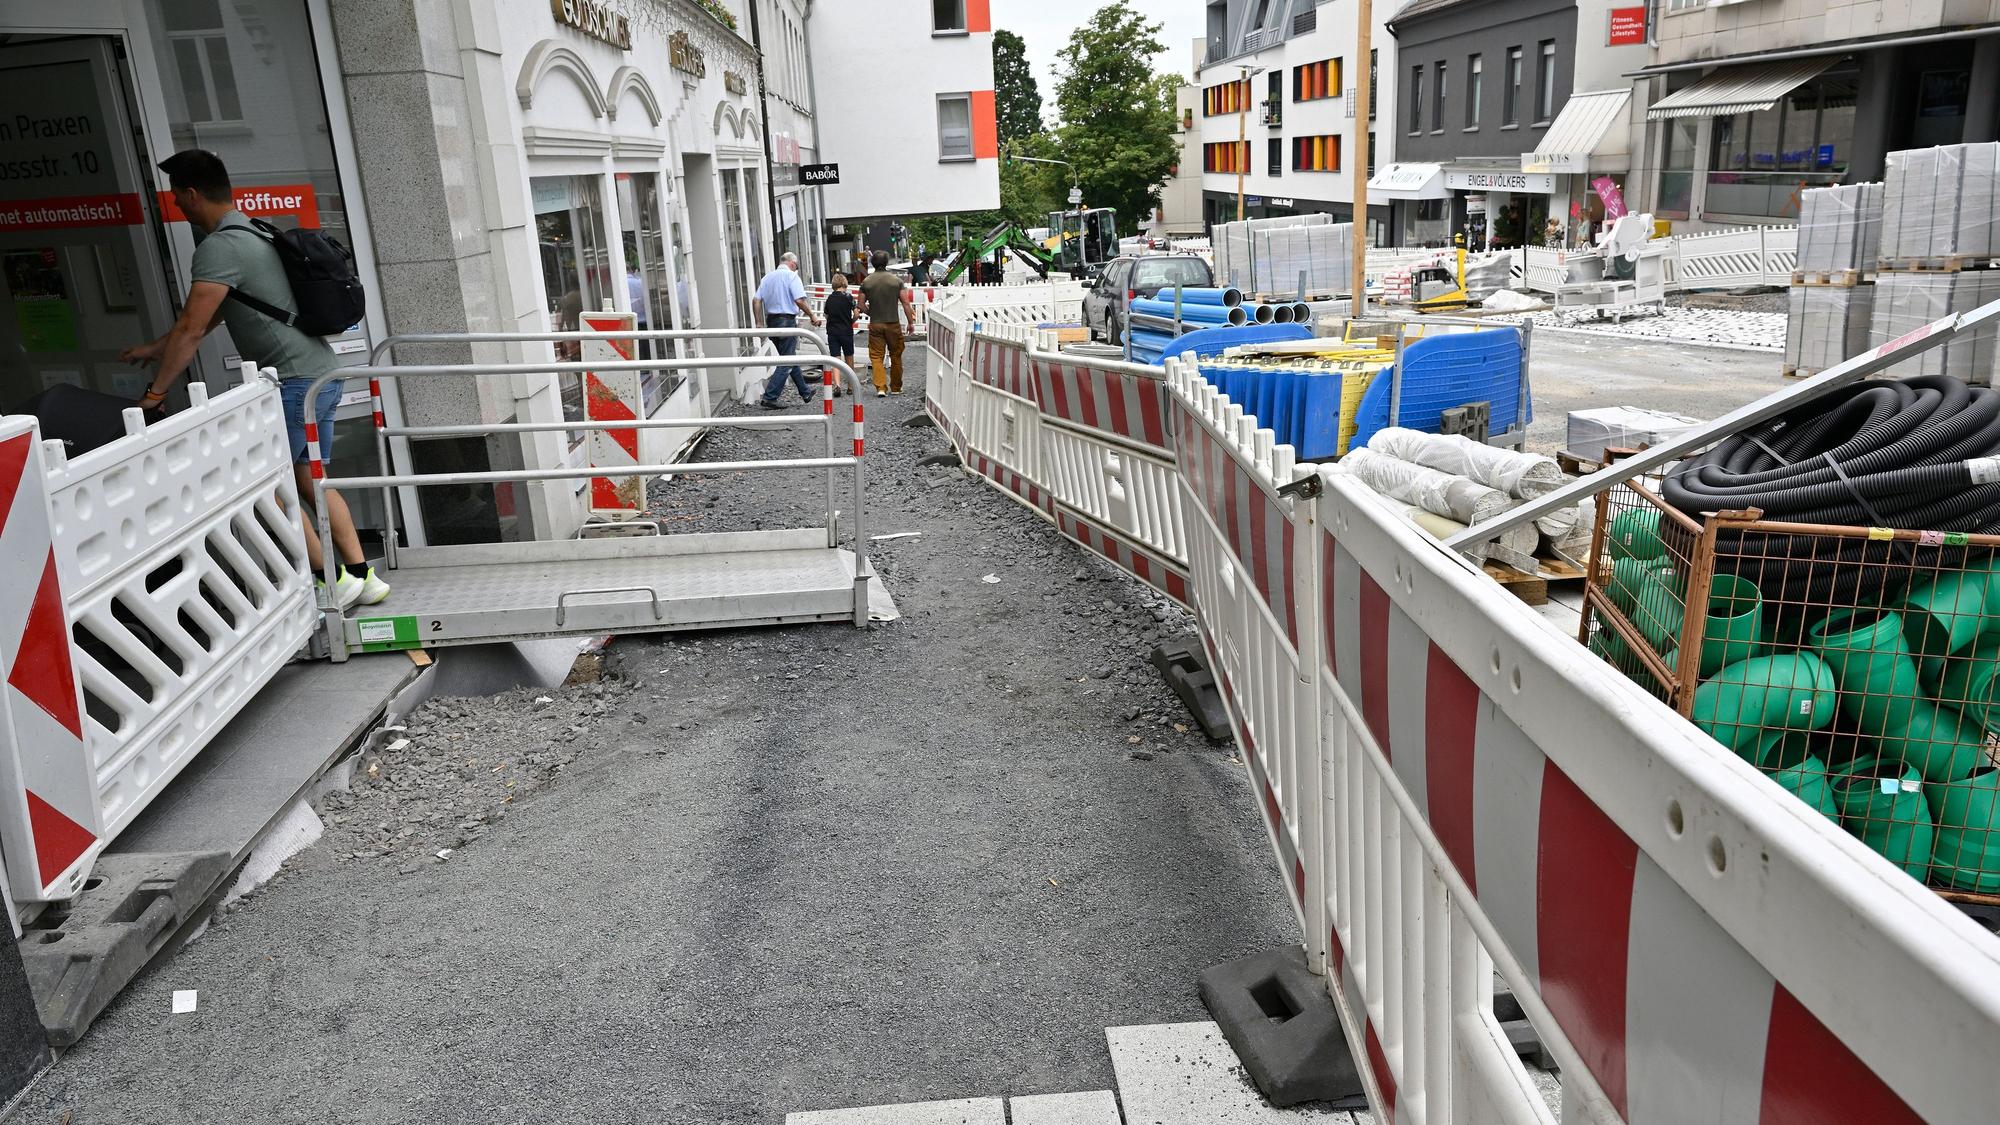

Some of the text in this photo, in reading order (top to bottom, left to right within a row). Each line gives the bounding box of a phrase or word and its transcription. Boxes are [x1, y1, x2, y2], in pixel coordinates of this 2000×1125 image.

[16, 114, 92, 139] Praxen
[71, 150, 98, 175] 10
[805, 169, 838, 181] BABOR
[24, 201, 122, 223] automatisch!
[431, 620, 443, 632] 2
